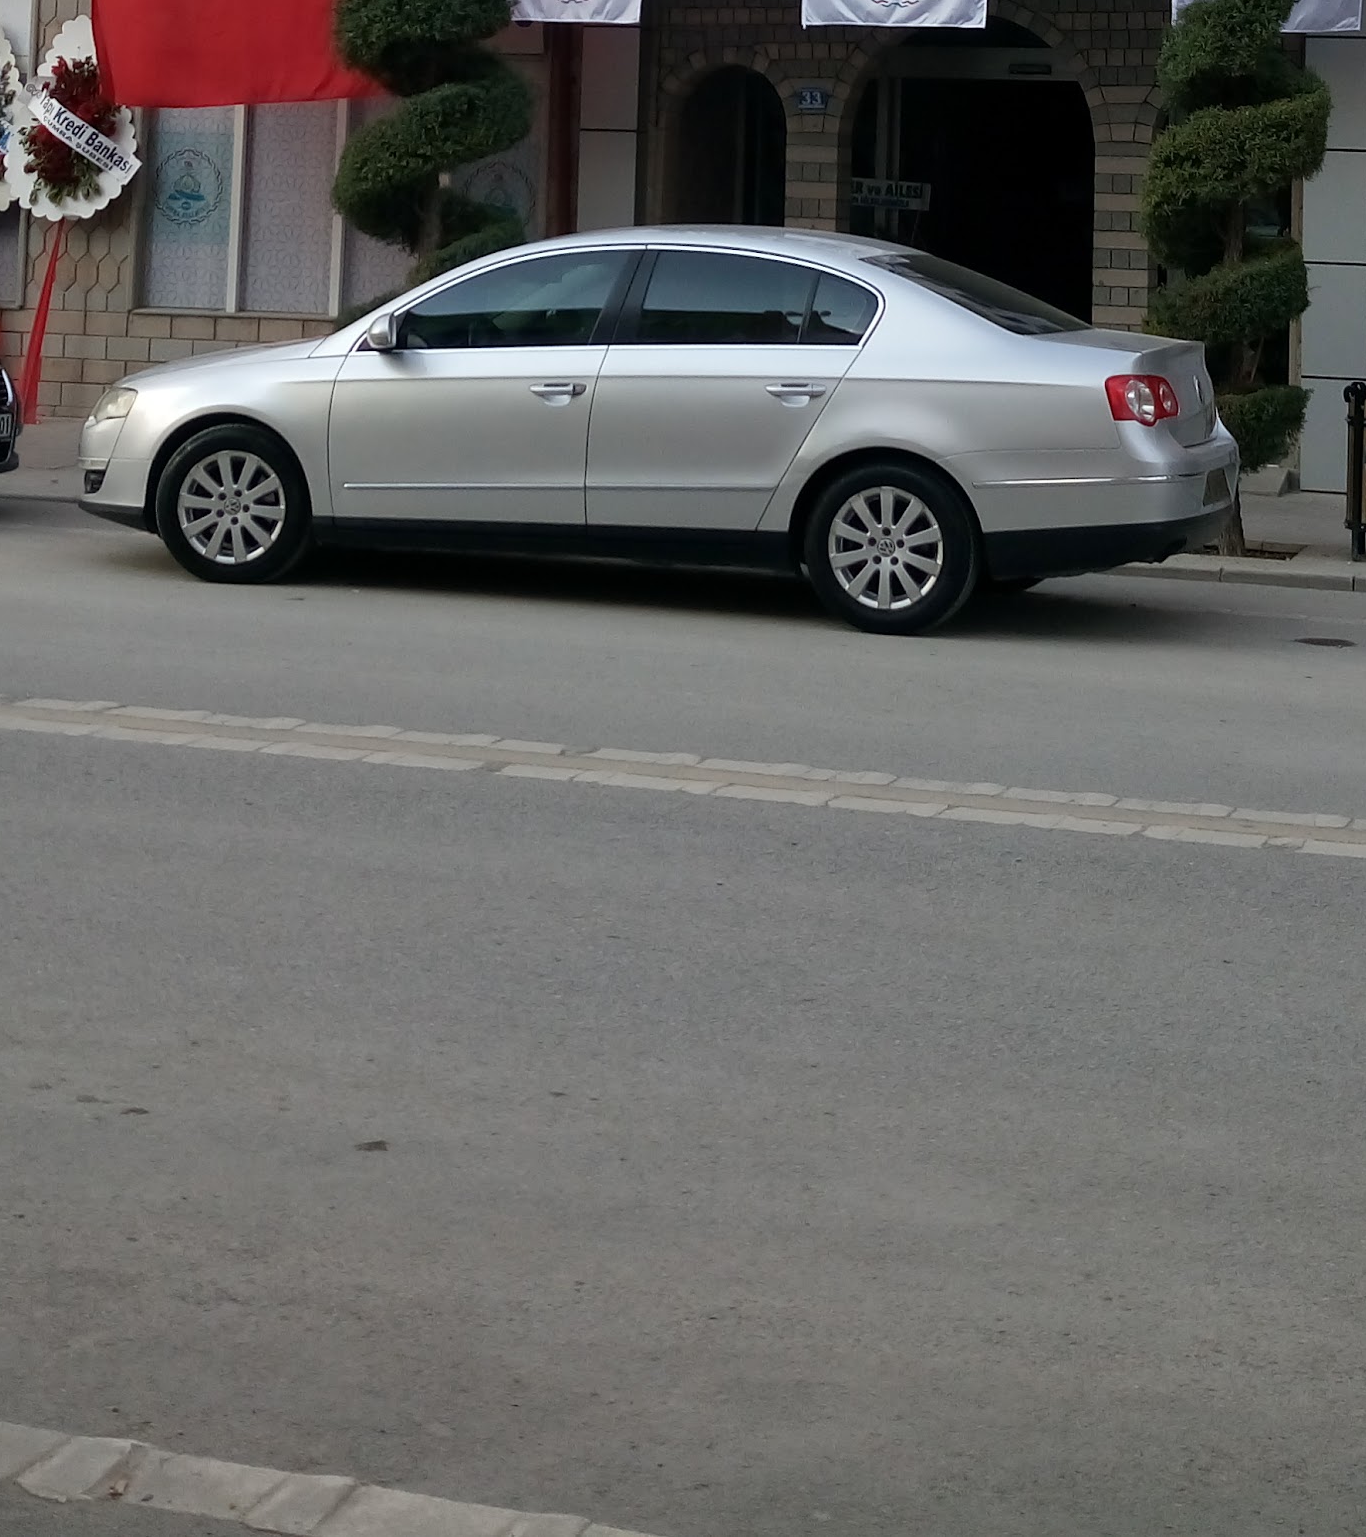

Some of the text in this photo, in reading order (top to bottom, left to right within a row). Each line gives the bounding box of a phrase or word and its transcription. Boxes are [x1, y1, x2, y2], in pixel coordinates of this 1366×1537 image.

[801, 90, 822, 105] 33
[52, 106, 87, 140] Kredi
[84, 130, 134, 174] Bankası
